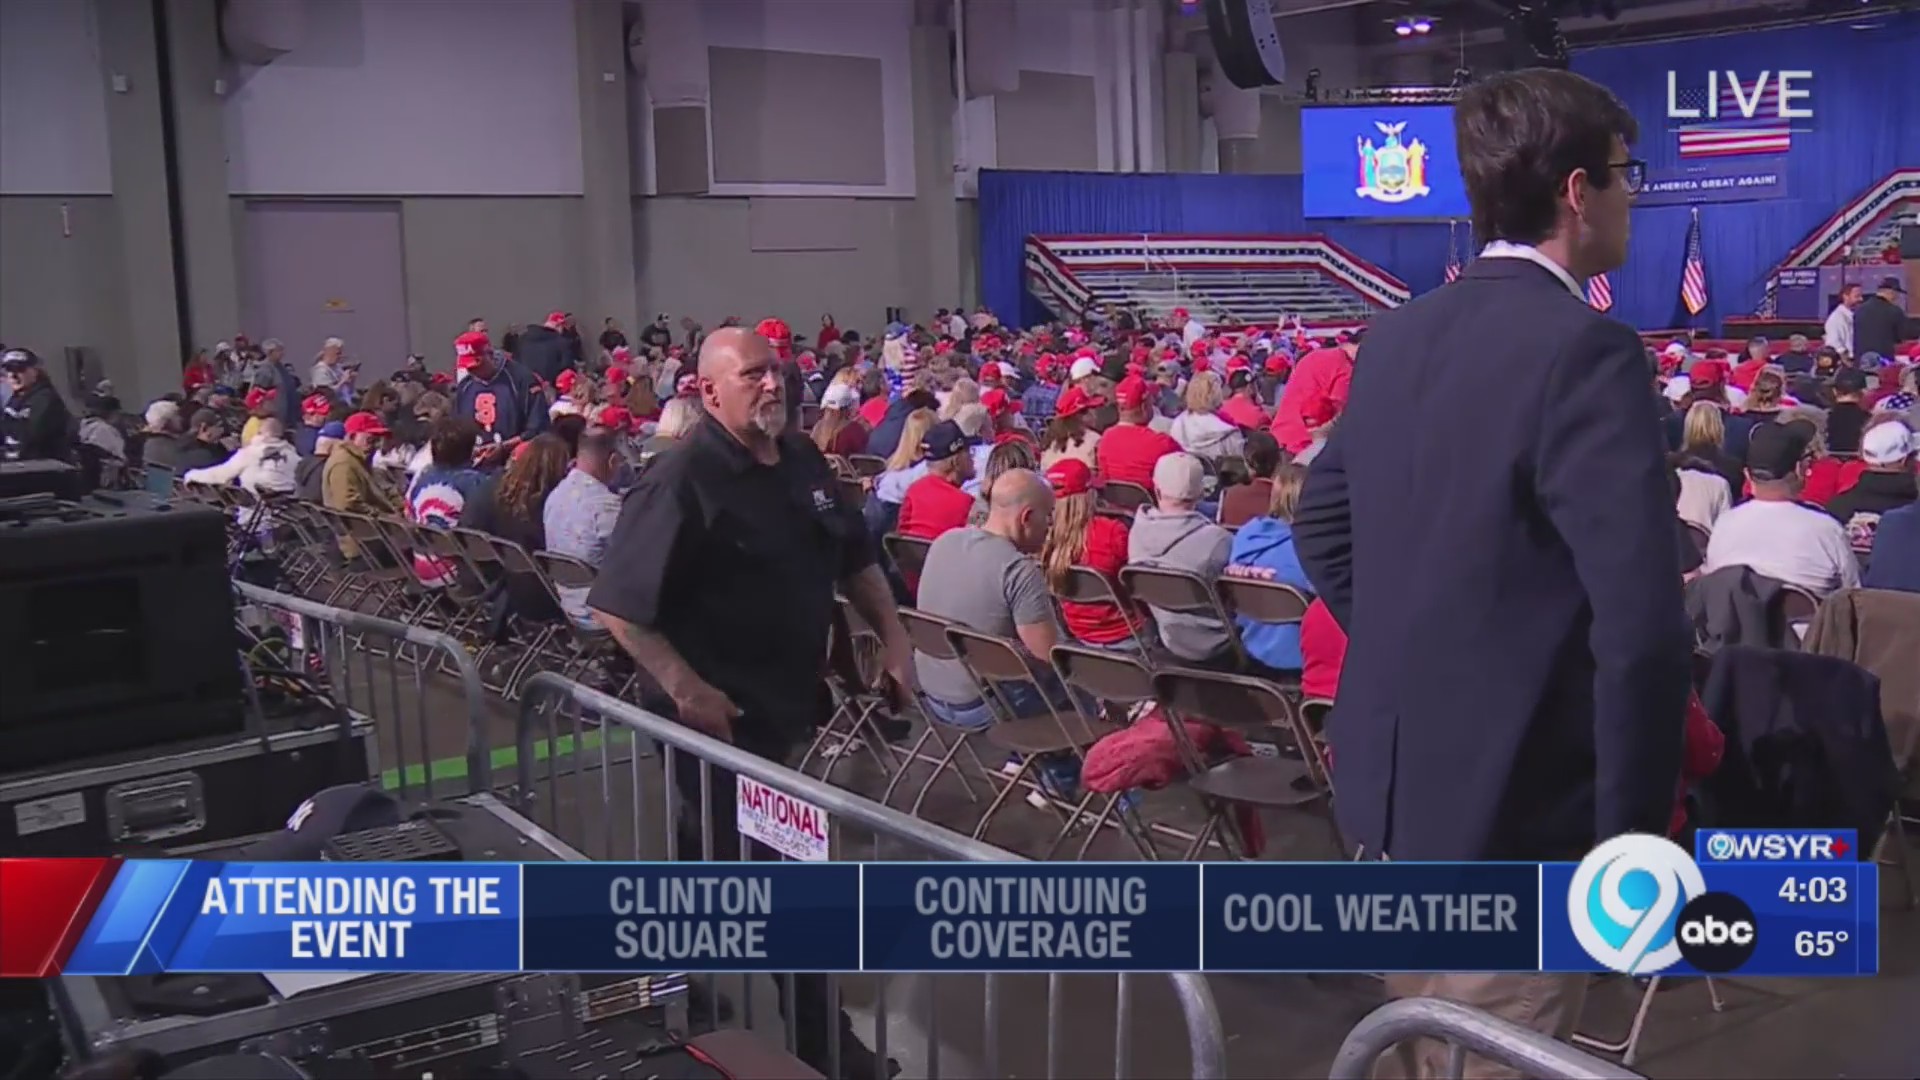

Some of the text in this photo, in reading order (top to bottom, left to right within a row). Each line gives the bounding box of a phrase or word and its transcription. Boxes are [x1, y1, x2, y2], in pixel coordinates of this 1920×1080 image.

[1653, 180, 1698, 192] AMERICA
[1701, 177, 1734, 189] GREAT
[1738, 175, 1777, 186] AGAIN!
[742, 779, 825, 842] NATIONAL
